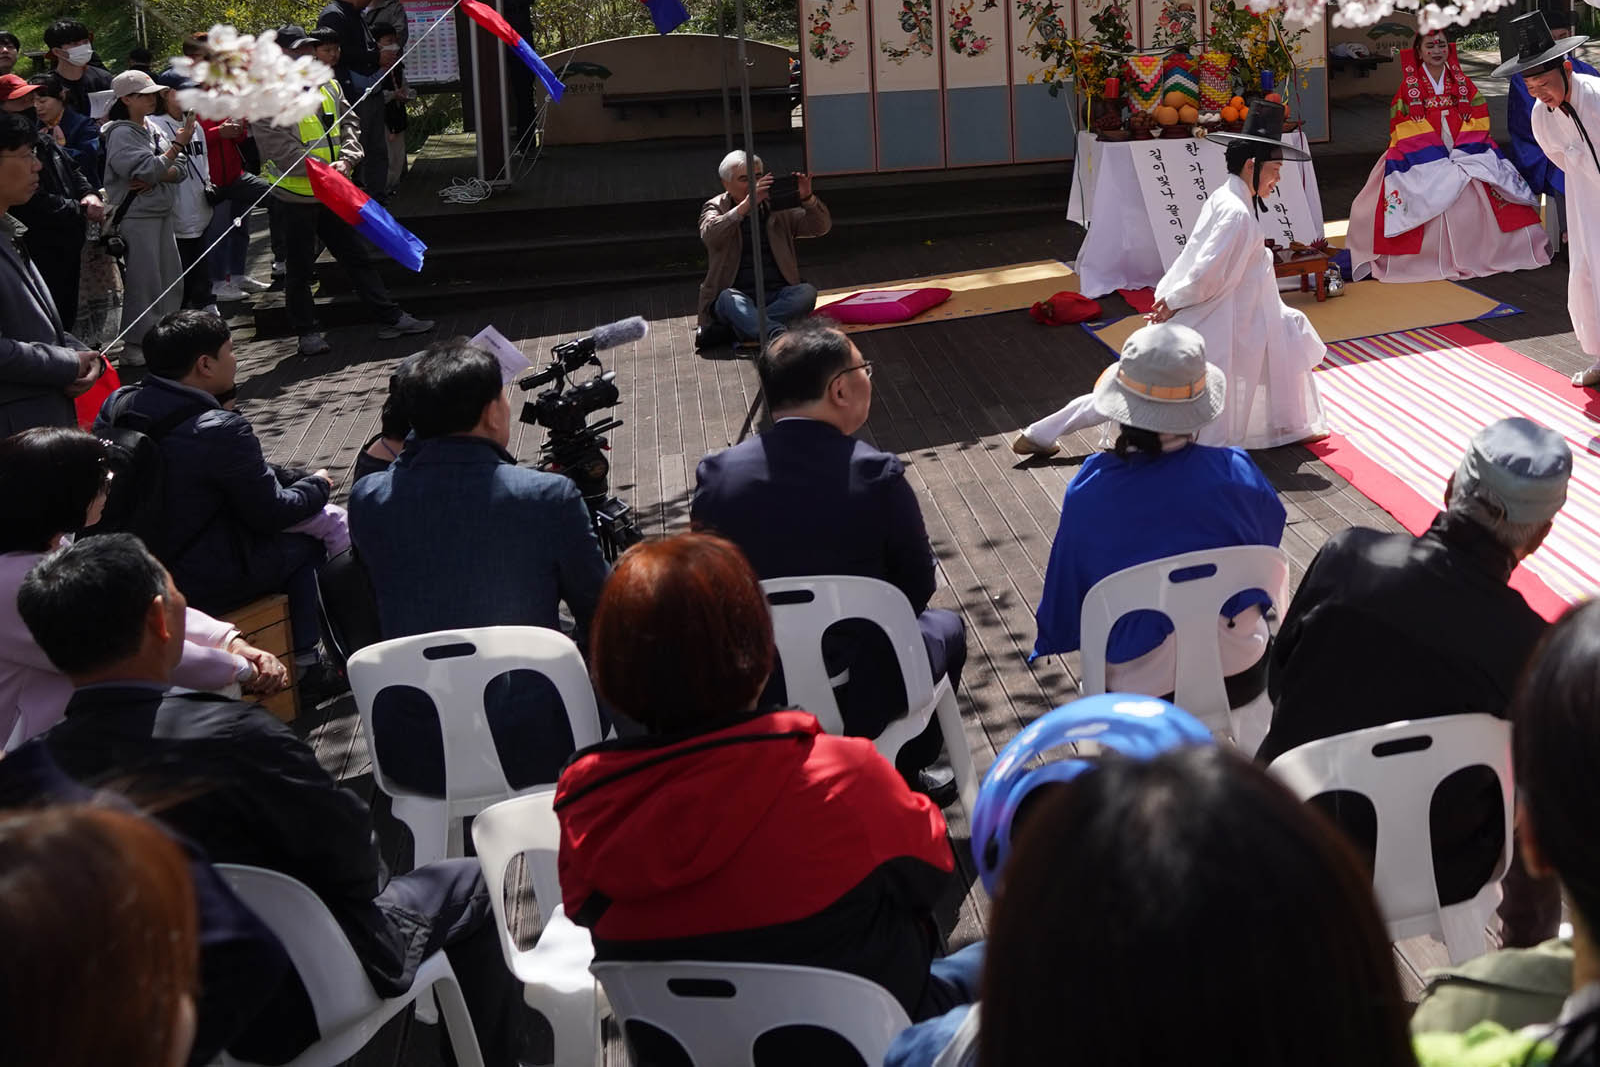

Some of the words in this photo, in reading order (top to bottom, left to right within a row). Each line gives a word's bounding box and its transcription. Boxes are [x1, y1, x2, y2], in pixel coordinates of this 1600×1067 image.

[1185, 142, 1199, 157] 한
[1189, 162, 1209, 201] 가정이
[1166, 204, 1183, 229] 끝이
[1174, 233, 1188, 255] 없
